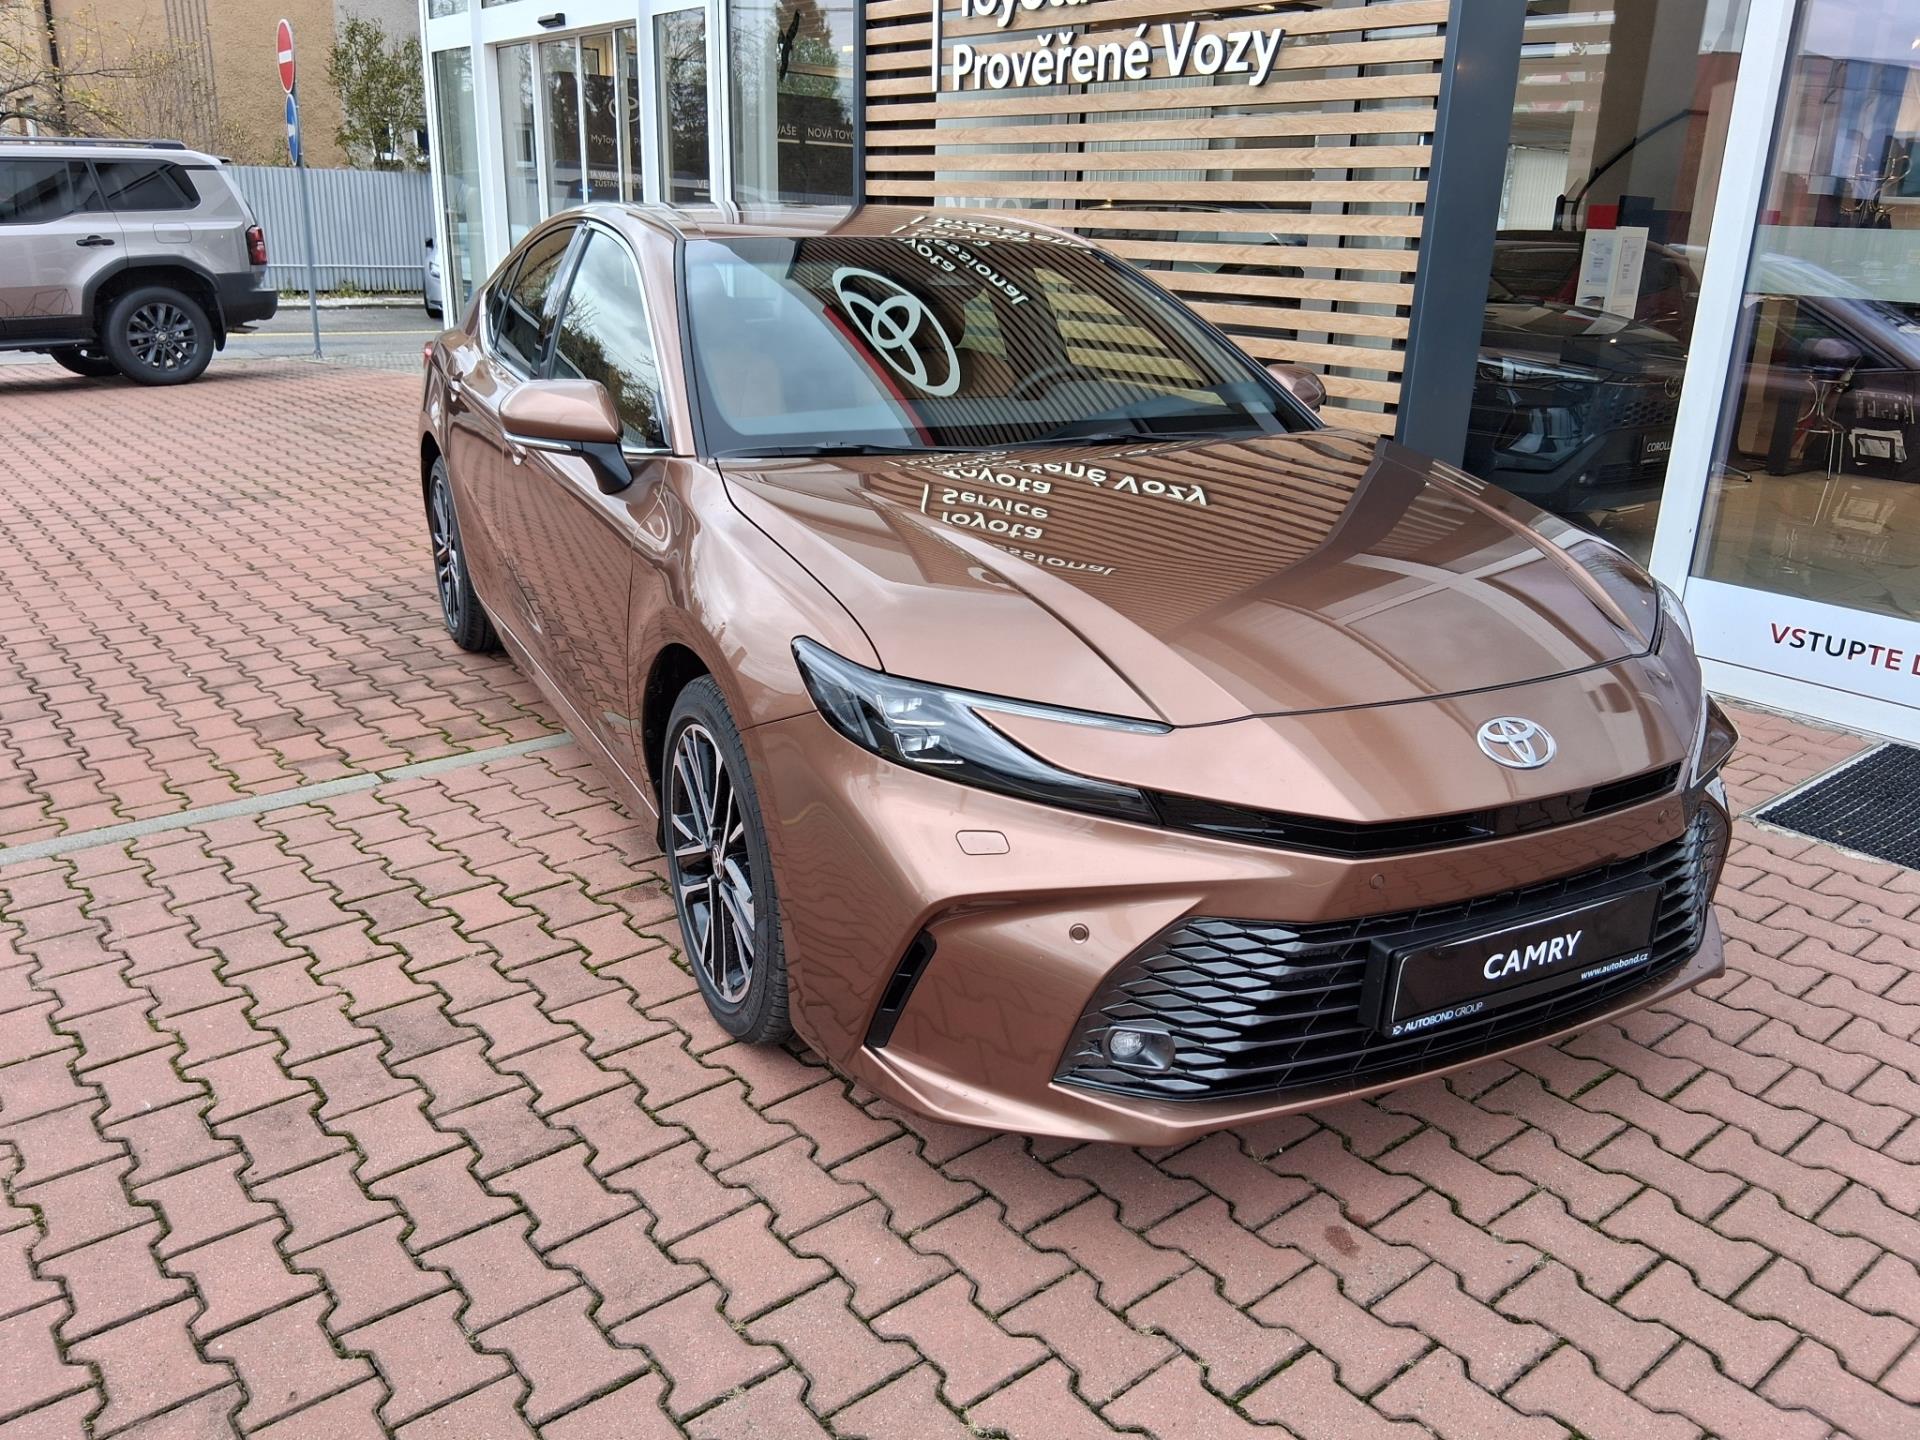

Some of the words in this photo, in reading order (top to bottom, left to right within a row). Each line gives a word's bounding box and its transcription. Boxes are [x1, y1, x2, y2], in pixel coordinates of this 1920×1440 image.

[952, 24, 1151, 91] Prověřené
[1161, 21, 1285, 87] Vozy
[1647, 440, 1671, 453] COROLL
[1771, 623, 1903, 671] VSTUPTE
[1483, 930, 1582, 980] CAMRY
[1580, 953, 1648, 980] www.autobond.cz
[1404, 1010, 1454, 1032] AUTOBOND
[1454, 1001, 1483, 1017] GROUP
